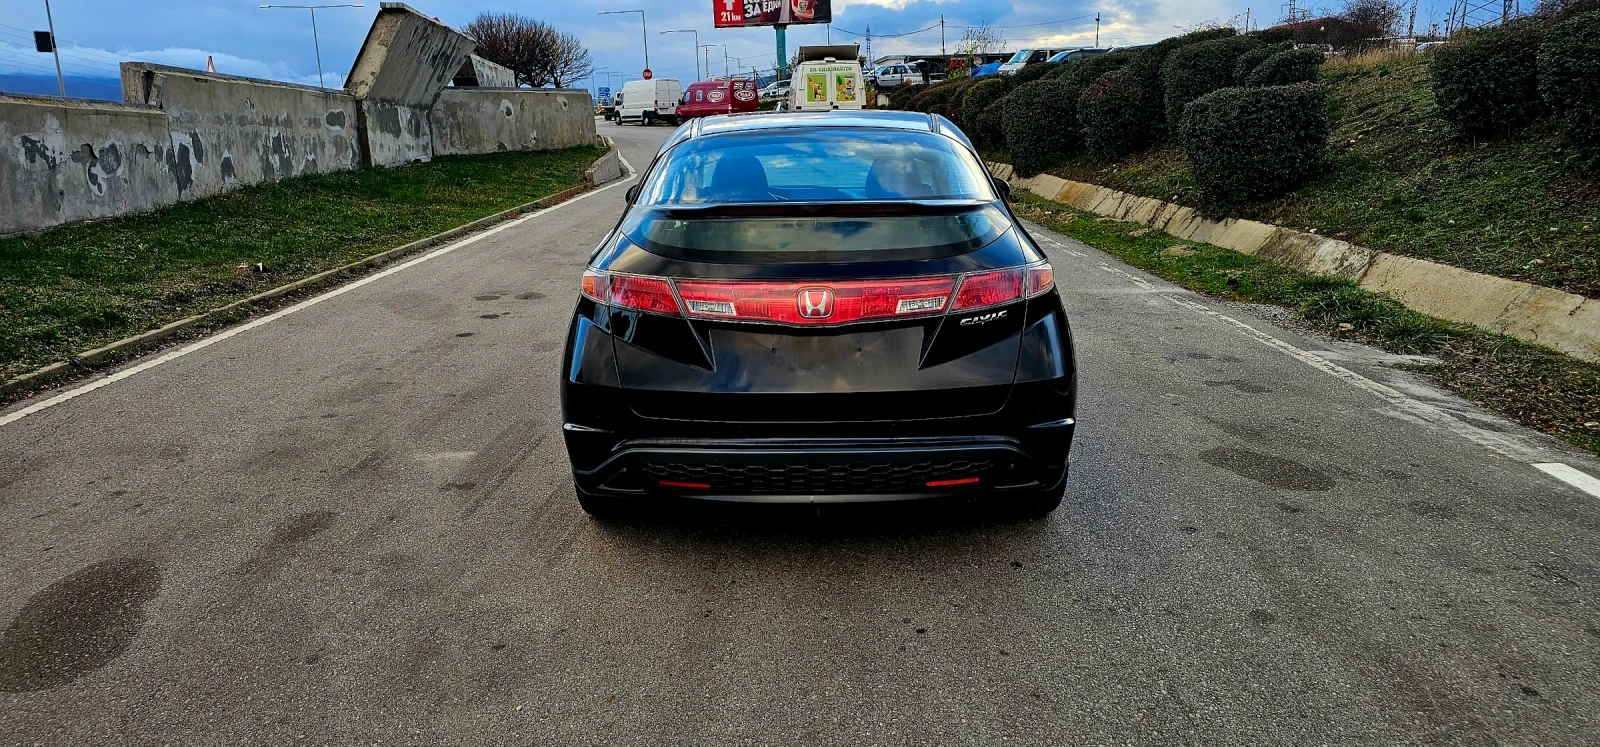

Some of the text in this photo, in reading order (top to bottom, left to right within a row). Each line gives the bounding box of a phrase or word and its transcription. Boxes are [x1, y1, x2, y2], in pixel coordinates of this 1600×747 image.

[721, 11, 742, 21] 21 km
[744, 3, 761, 18] ЗА
[959, 310, 1008, 326] CIVIC
